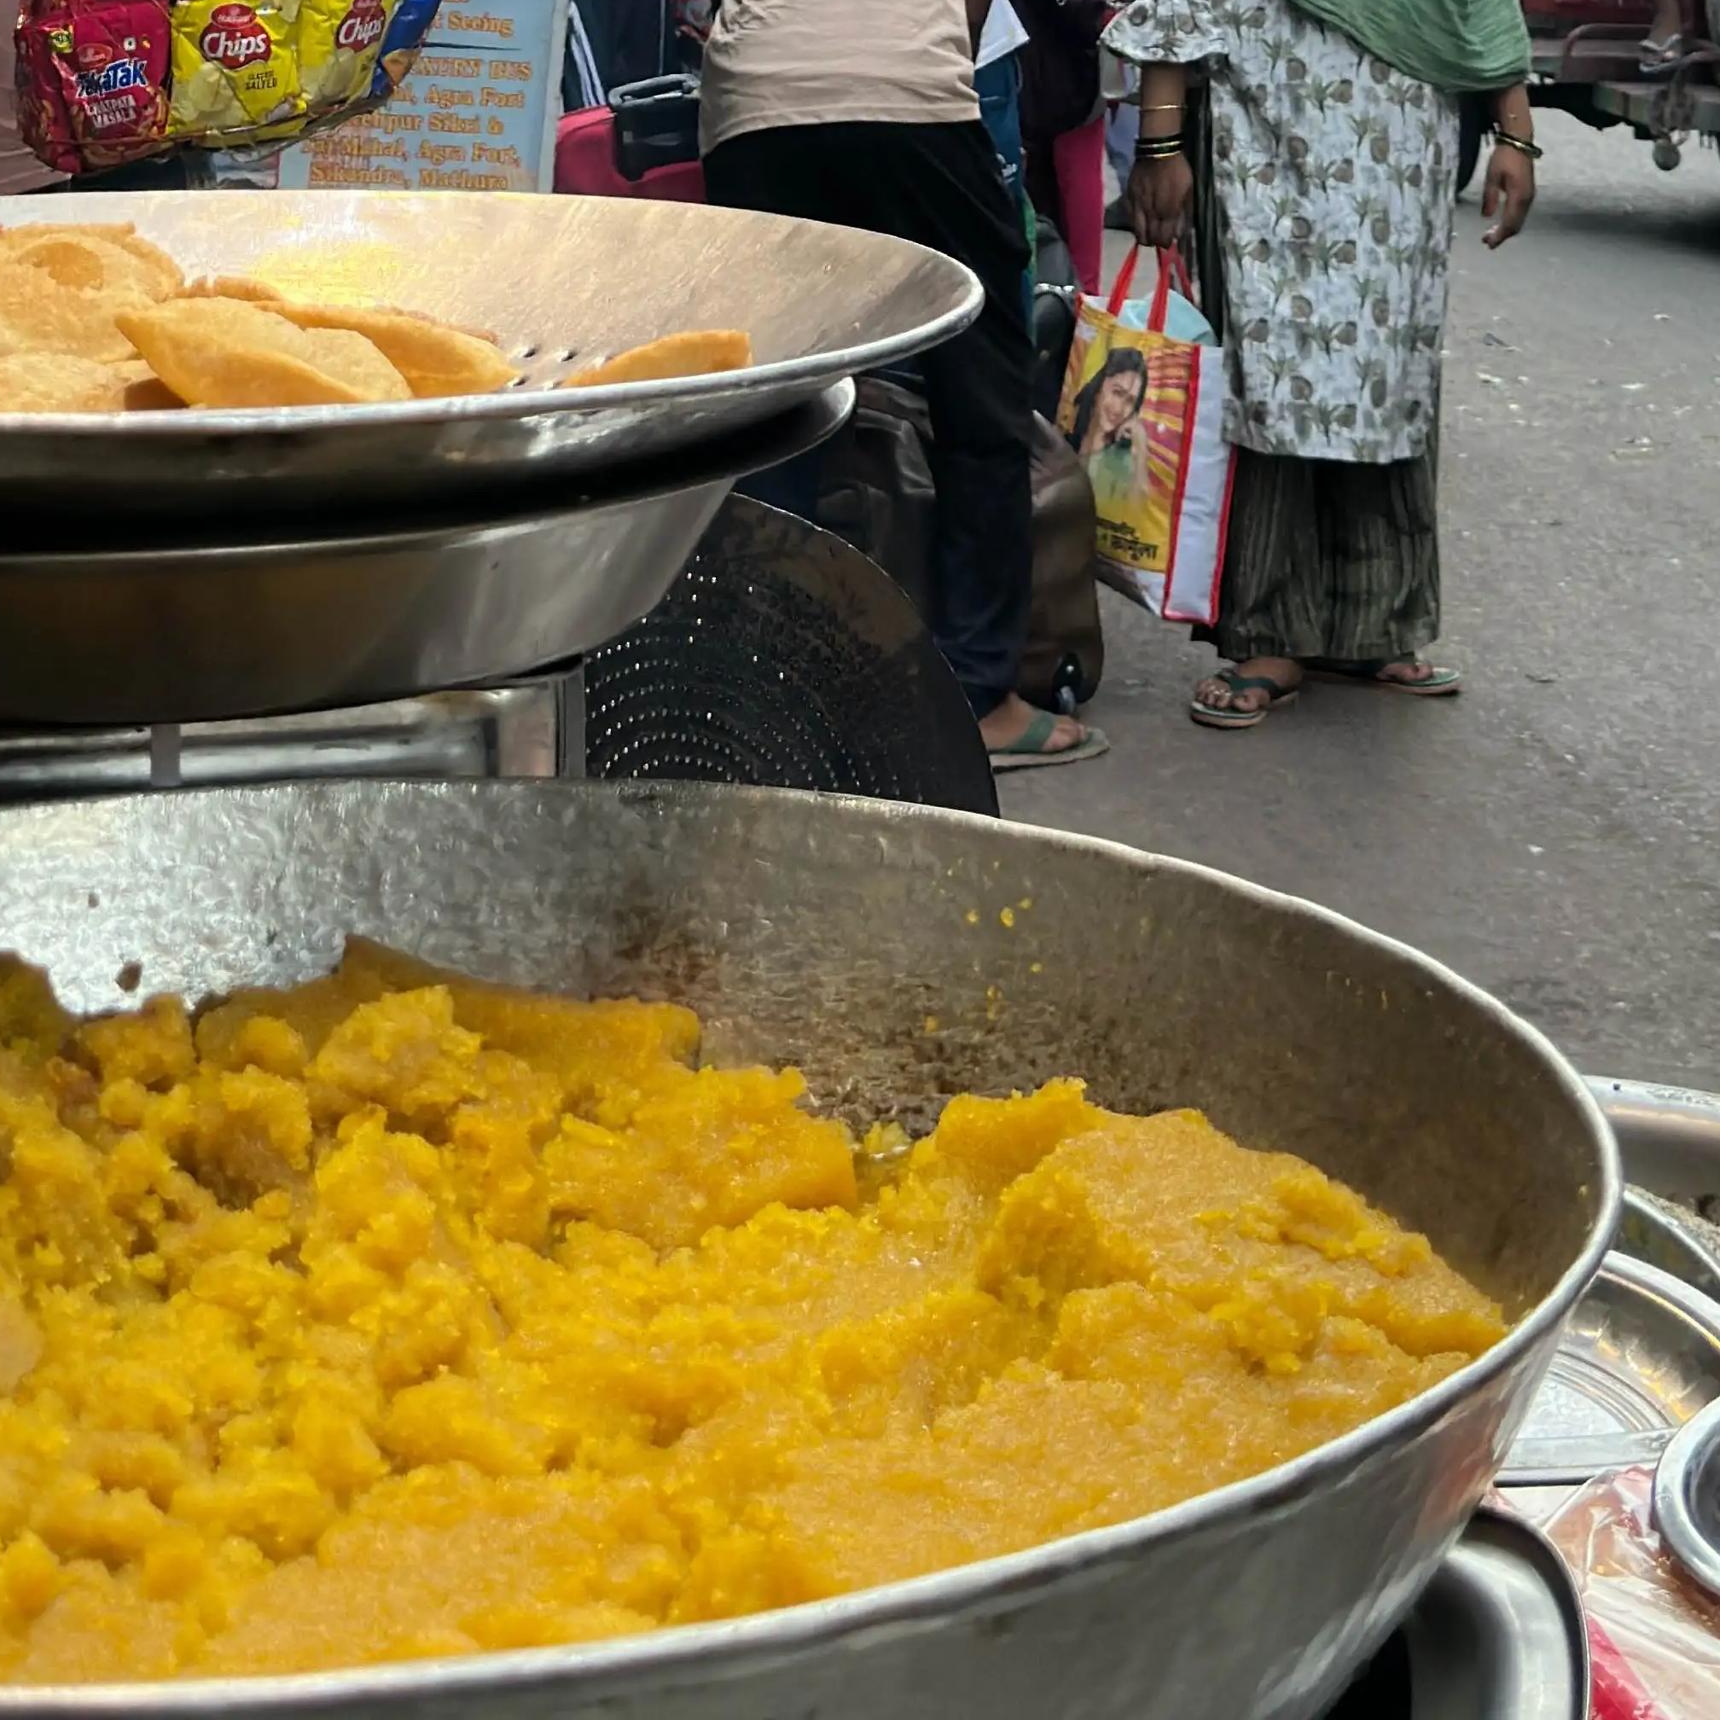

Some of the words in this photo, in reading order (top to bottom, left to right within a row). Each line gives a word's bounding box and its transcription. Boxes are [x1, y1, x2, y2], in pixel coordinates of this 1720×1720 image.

[448, 12, 513, 38] Seeing
[203, 31, 268, 59] Chips
[425, 84, 474, 109] Agra
[481, 87, 525, 109] Fort
[417, 140, 466, 166] Agra
